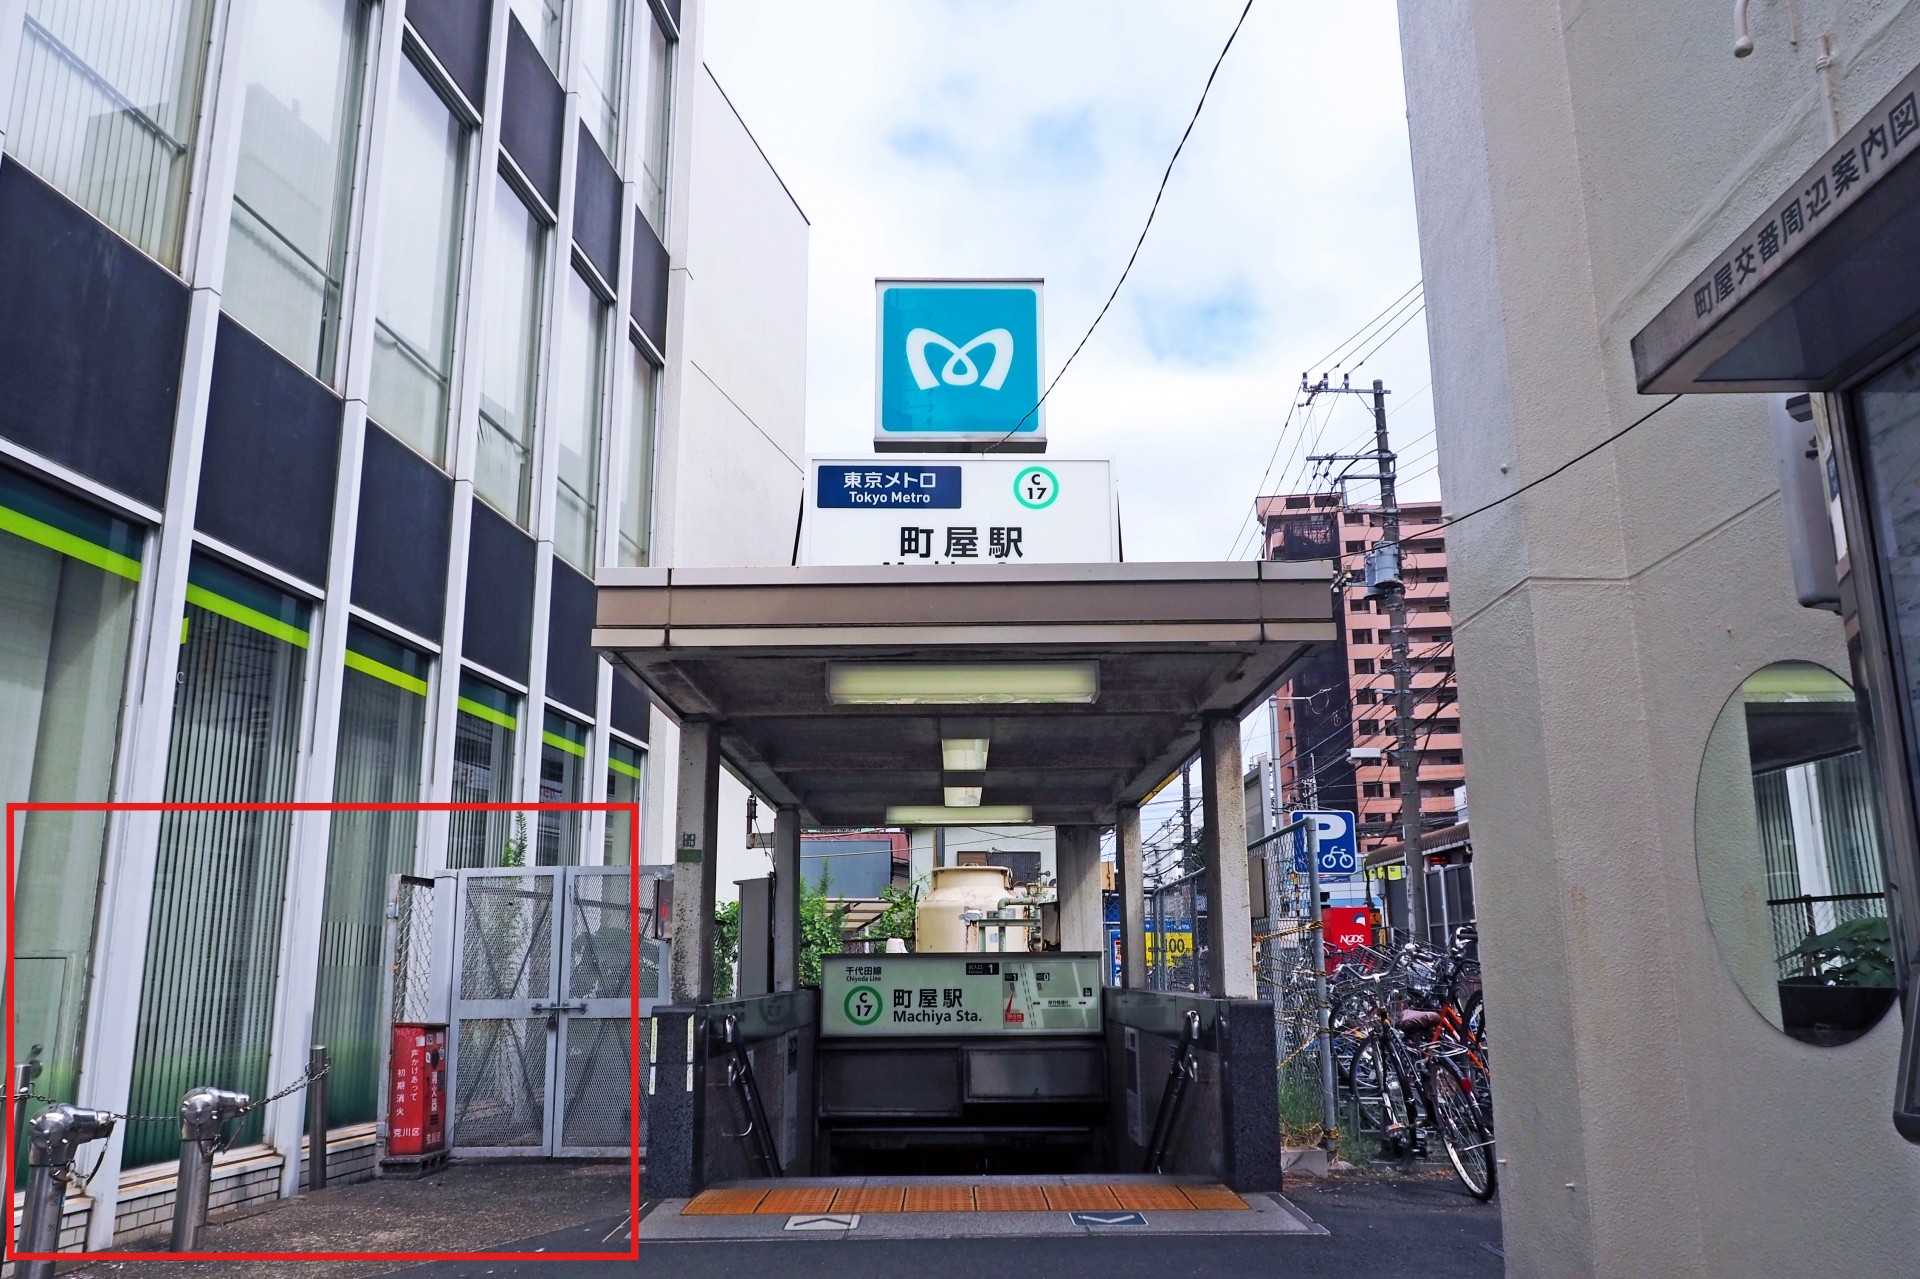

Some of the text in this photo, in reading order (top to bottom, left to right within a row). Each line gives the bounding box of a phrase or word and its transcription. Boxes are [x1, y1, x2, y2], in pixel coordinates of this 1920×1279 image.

[1693, 91, 1919, 319] 町屋交番周辺案内図
[843, 471, 936, 489] 東京メトロ
[1031, 473, 1041, 486] C
[849, 491, 931, 505] Tokyo Metro
[1027, 487, 1047, 500] 17
[900, 526, 1024, 558] 町屋駅
[846, 966, 882, 976] 千代田線
[988, 963, 993, 974] 1
[859, 992, 868, 1004] C
[893, 988, 963, 1008] 町屋駅
[855, 1004, 873, 1017] 17
[893, 1010, 982, 1025] Machiya Sta.
[410, 1049, 419, 1102] 声かけあって
[396, 1068, 406, 1116] 初期消火
[393, 1127, 420, 1138] 荒川区
